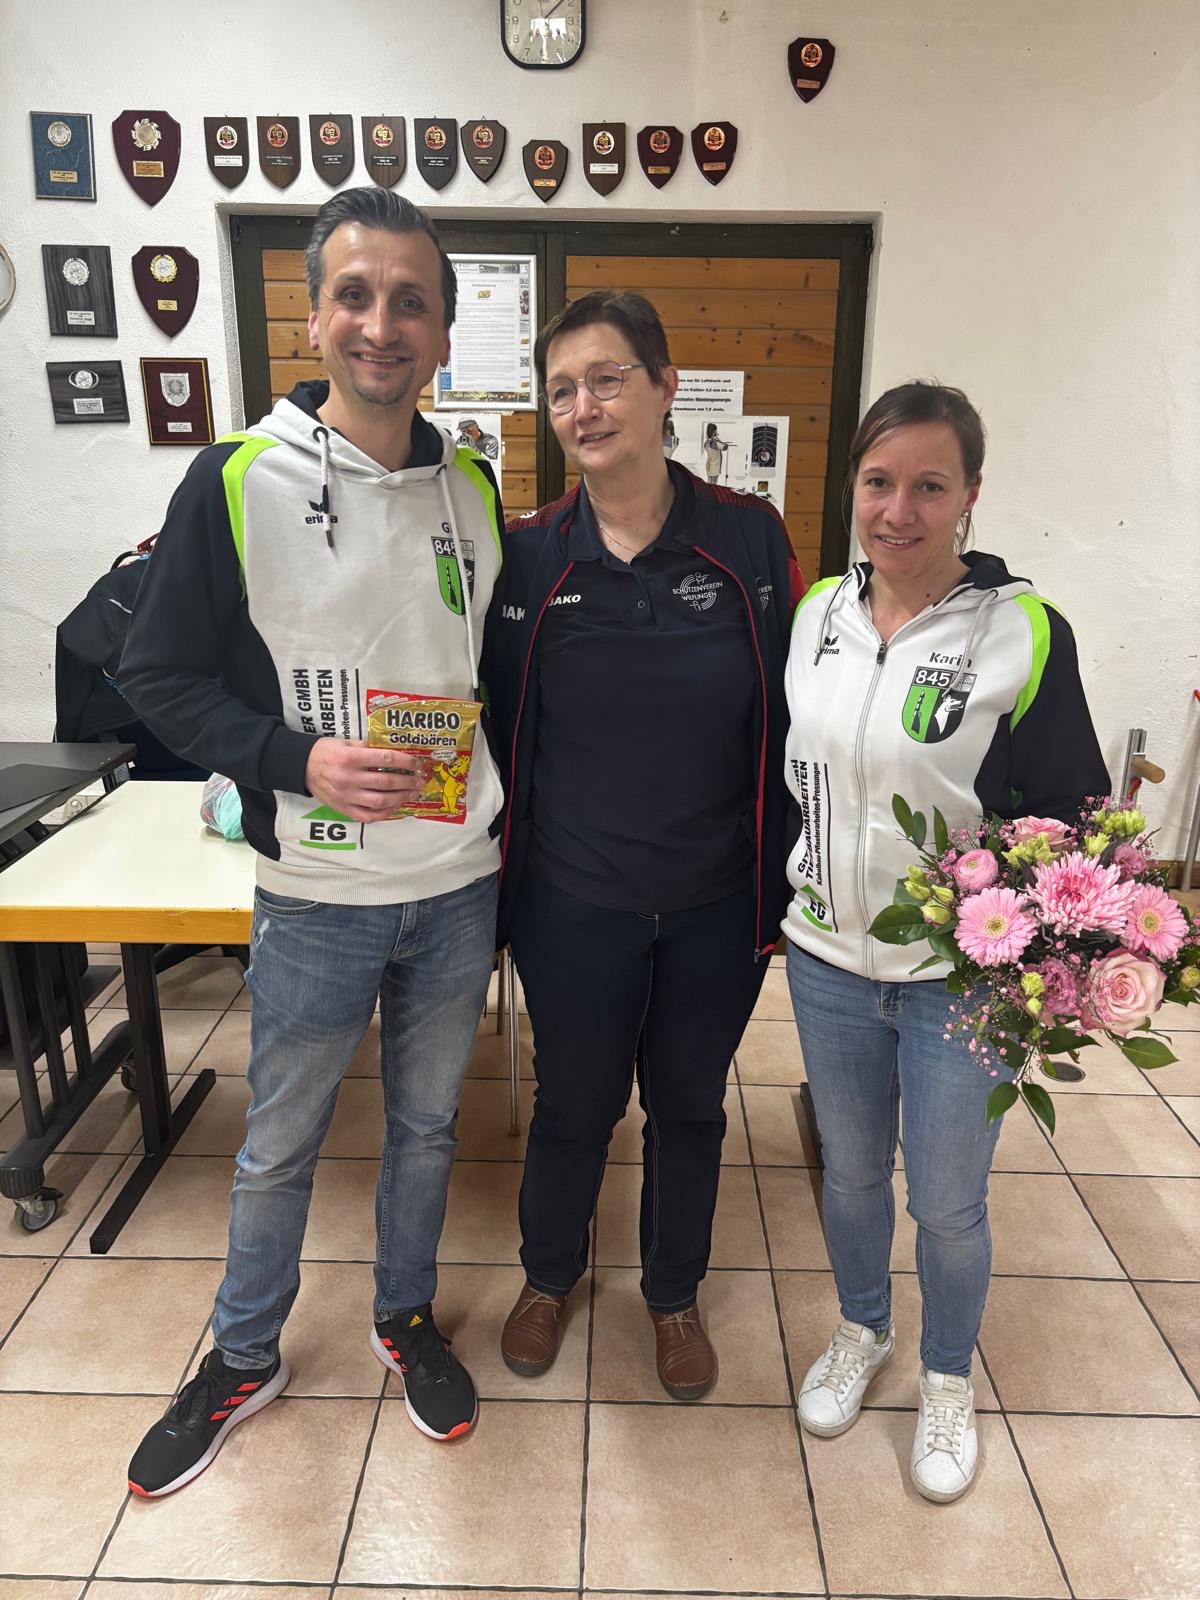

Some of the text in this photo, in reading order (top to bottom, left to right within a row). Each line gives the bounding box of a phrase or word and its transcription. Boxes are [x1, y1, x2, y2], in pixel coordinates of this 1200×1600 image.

[512, 16, 519, 24] 9
[568, 17, 574, 25] 3
[513, 35, 519, 43] 8
[568, 36, 574, 45] 4
[525, 48, 530, 56] 7
[557, 48, 563, 56] 5
[305, 513, 338, 525] eria
[548, 594, 582, 606] JAKO
[502, 605, 526, 621] JAK
[822, 647, 840, 655] rima
[916, 670, 951, 687] 845
[292, 669, 317, 734] ER GMBH
[317, 669, 336, 738] ARBEITEN
[386, 709, 460, 730] HARIBO
[390, 732, 457, 747] Goldbären
[310, 822, 347, 841] EG
